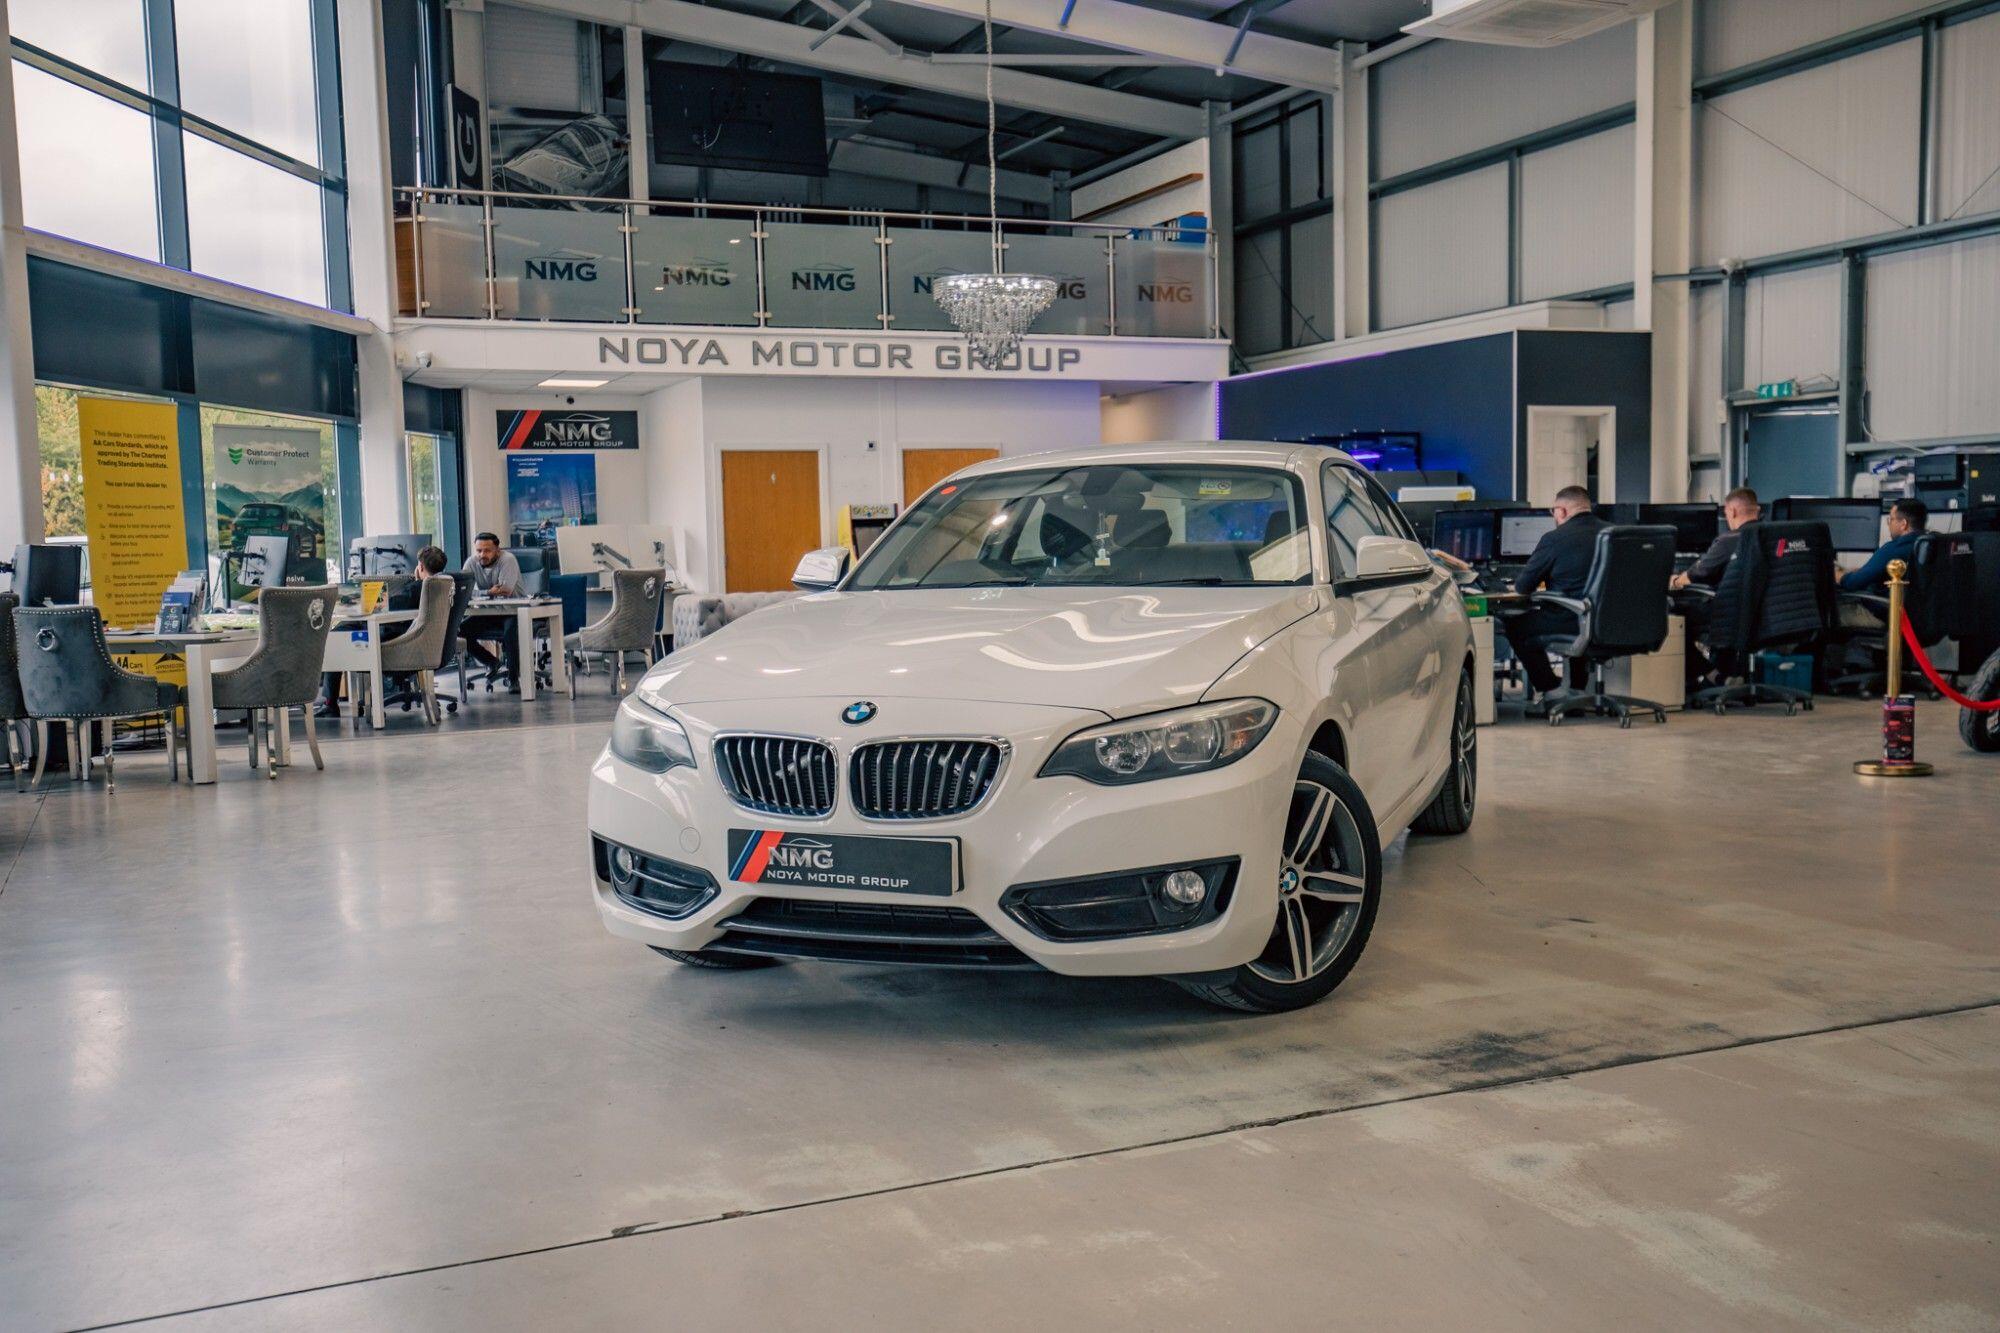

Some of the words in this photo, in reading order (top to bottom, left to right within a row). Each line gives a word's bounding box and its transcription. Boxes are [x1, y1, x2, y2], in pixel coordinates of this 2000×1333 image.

[524, 260, 597, 282] NMG
[663, 266, 730, 287] NMG
[791, 271, 856, 292] NMG
[1137, 284, 1192, 304] NMG
[599, 336, 729, 366] NOYA
[752, 340, 913, 370] MOTOR
[544, 422, 612, 441] NMG
[246, 448, 282, 457] Customer
[283, 450, 310, 458] Protect
[768, 846, 834, 869] NMG
[766, 869, 802, 880] NOYA
[808, 873, 856, 884] MOTOR
[861, 876, 910, 888] GROUP
